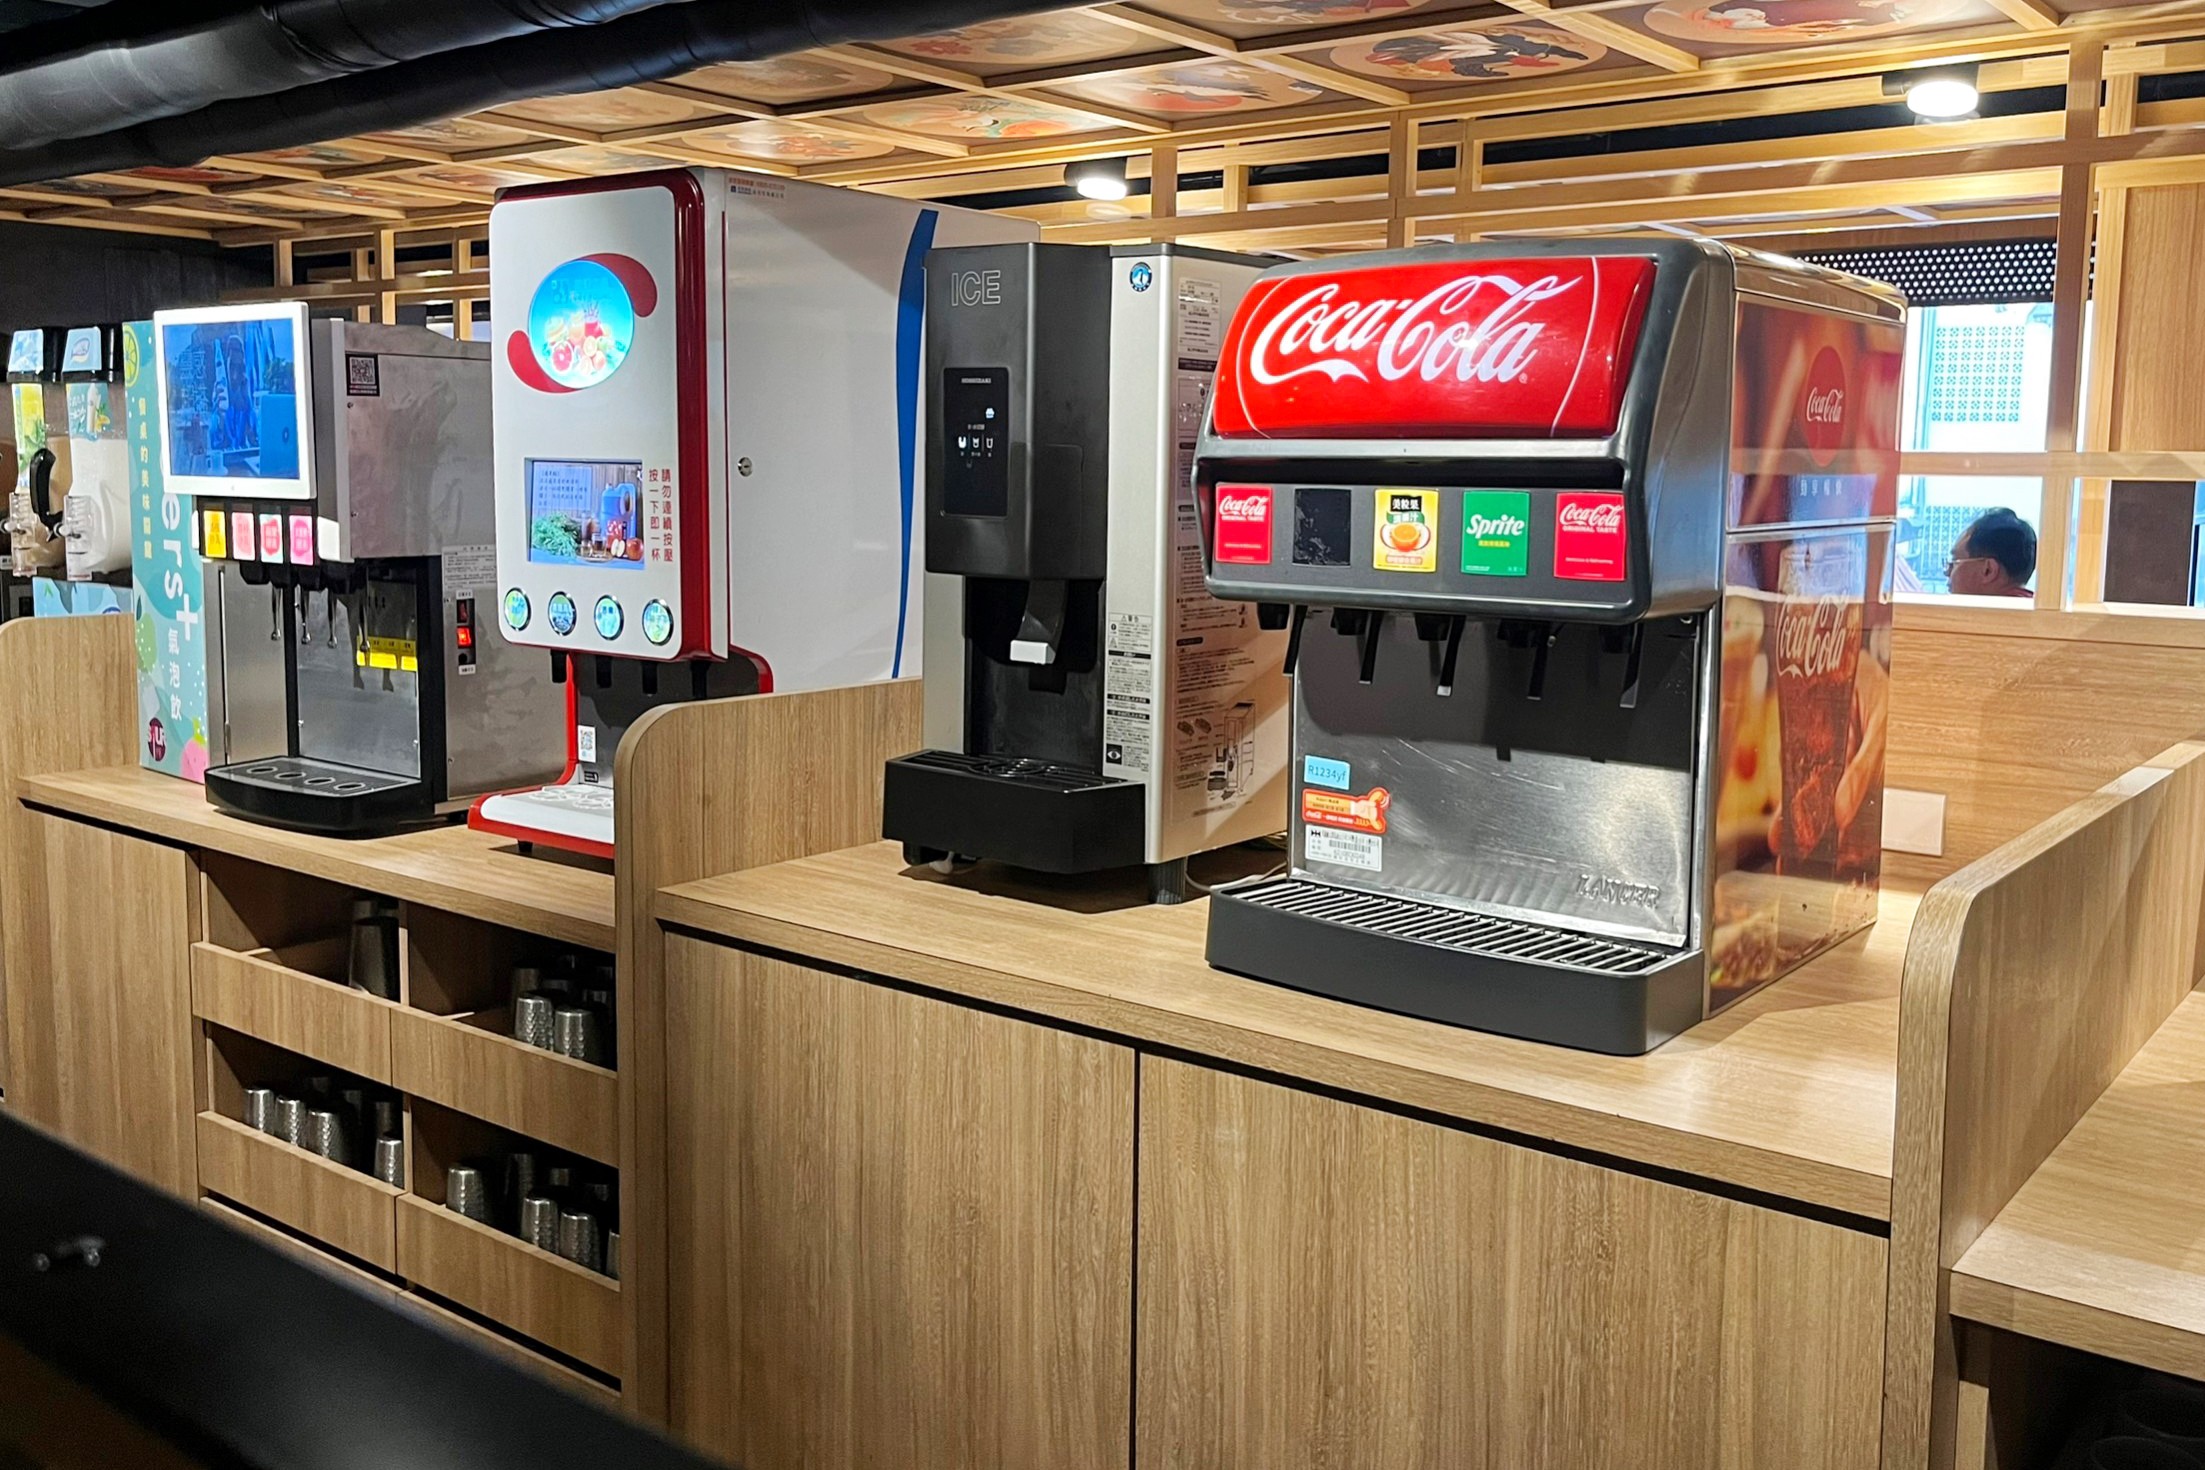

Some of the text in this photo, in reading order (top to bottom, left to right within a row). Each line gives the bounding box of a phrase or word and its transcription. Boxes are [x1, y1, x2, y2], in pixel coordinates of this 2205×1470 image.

[951, 269, 1001, 306] ICE
[1250, 275, 1583, 385] Coca-Cola
[1805, 386, 1843, 422] Coca-Cola
[648, 468, 661, 561] 按一下即一杯
[1219, 495, 1269, 516] Coca-Cola
[1392, 498, 1420, 511] 美粒果
[1559, 502, 1624, 527] Coca-Cola
[1466, 514, 1525, 539] Sprite
[1776, 590, 1849, 678] Coca-Cola
[168, 628, 182, 721] 氣泡飲
[1308, 764, 1346, 783] R1234yf
